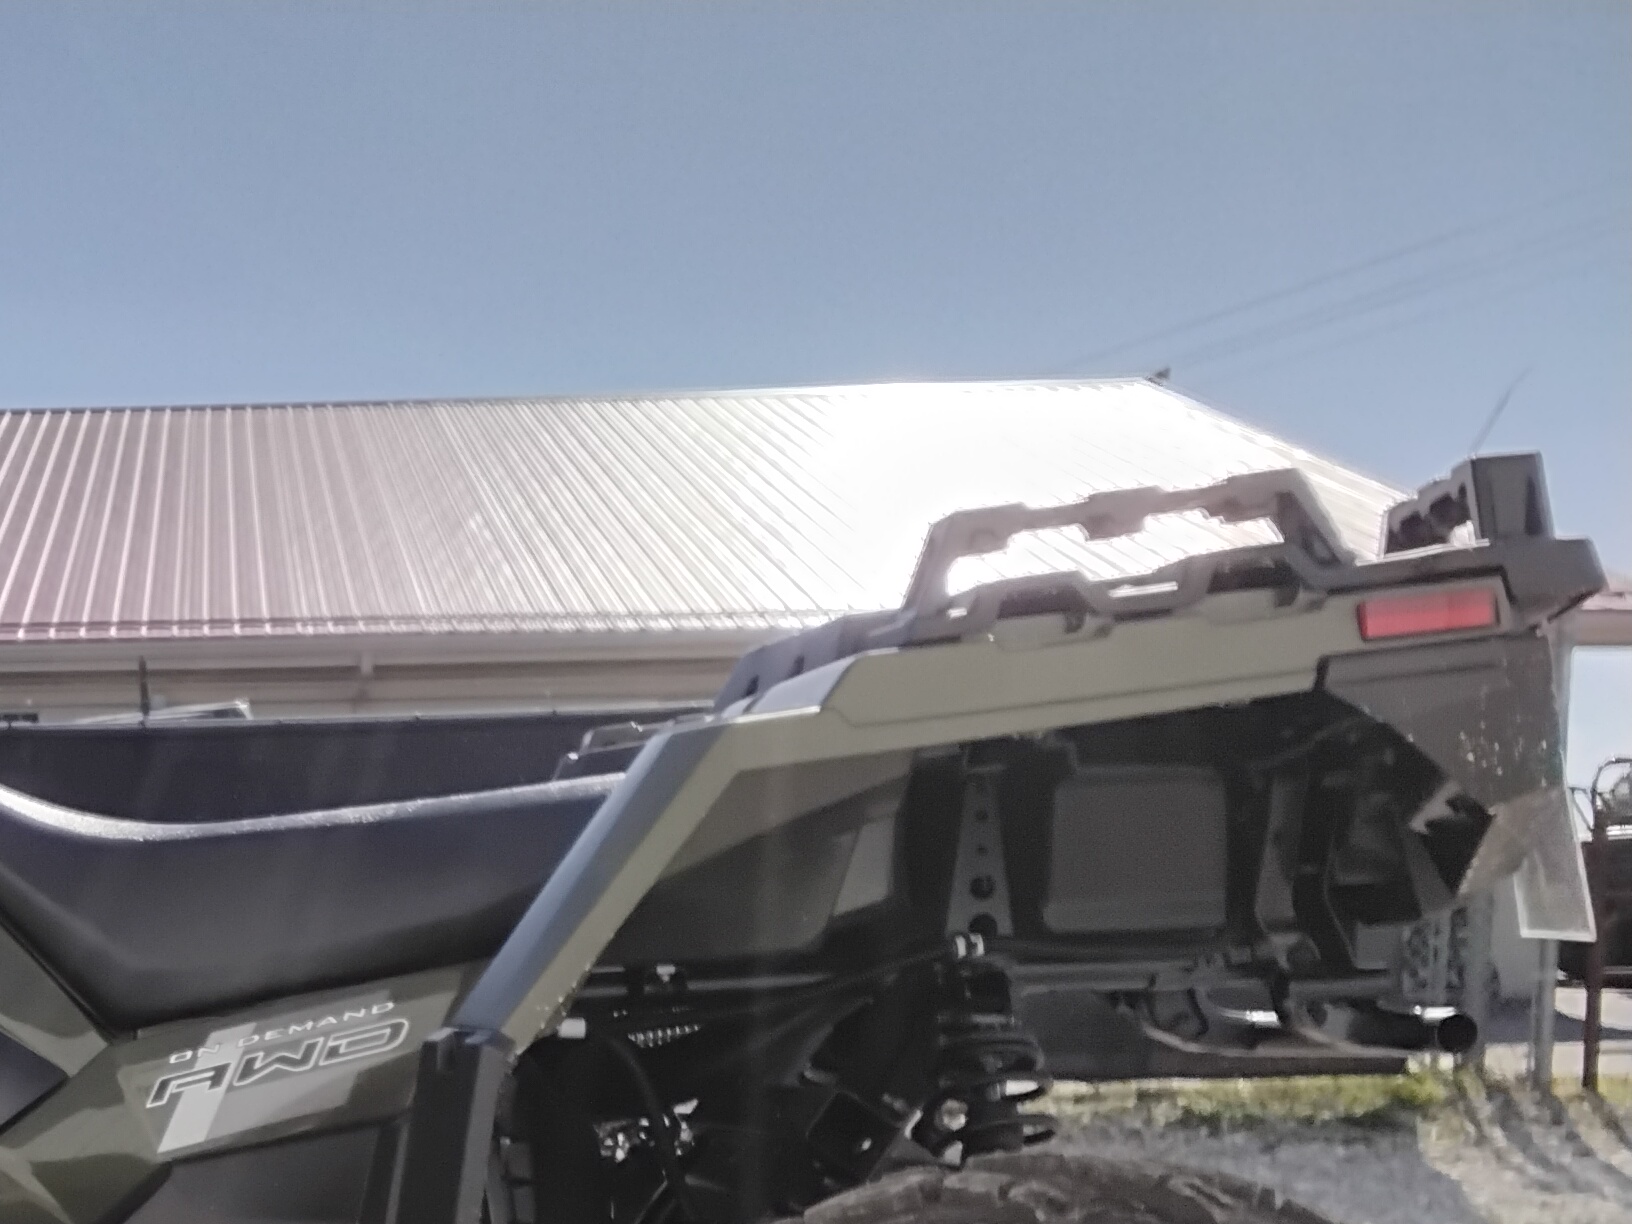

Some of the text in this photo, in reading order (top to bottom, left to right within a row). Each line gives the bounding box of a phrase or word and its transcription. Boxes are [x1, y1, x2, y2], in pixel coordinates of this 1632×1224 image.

[145, 1018, 410, 1108] AWD
[169, 1001, 395, 1064] ON DEMAND
